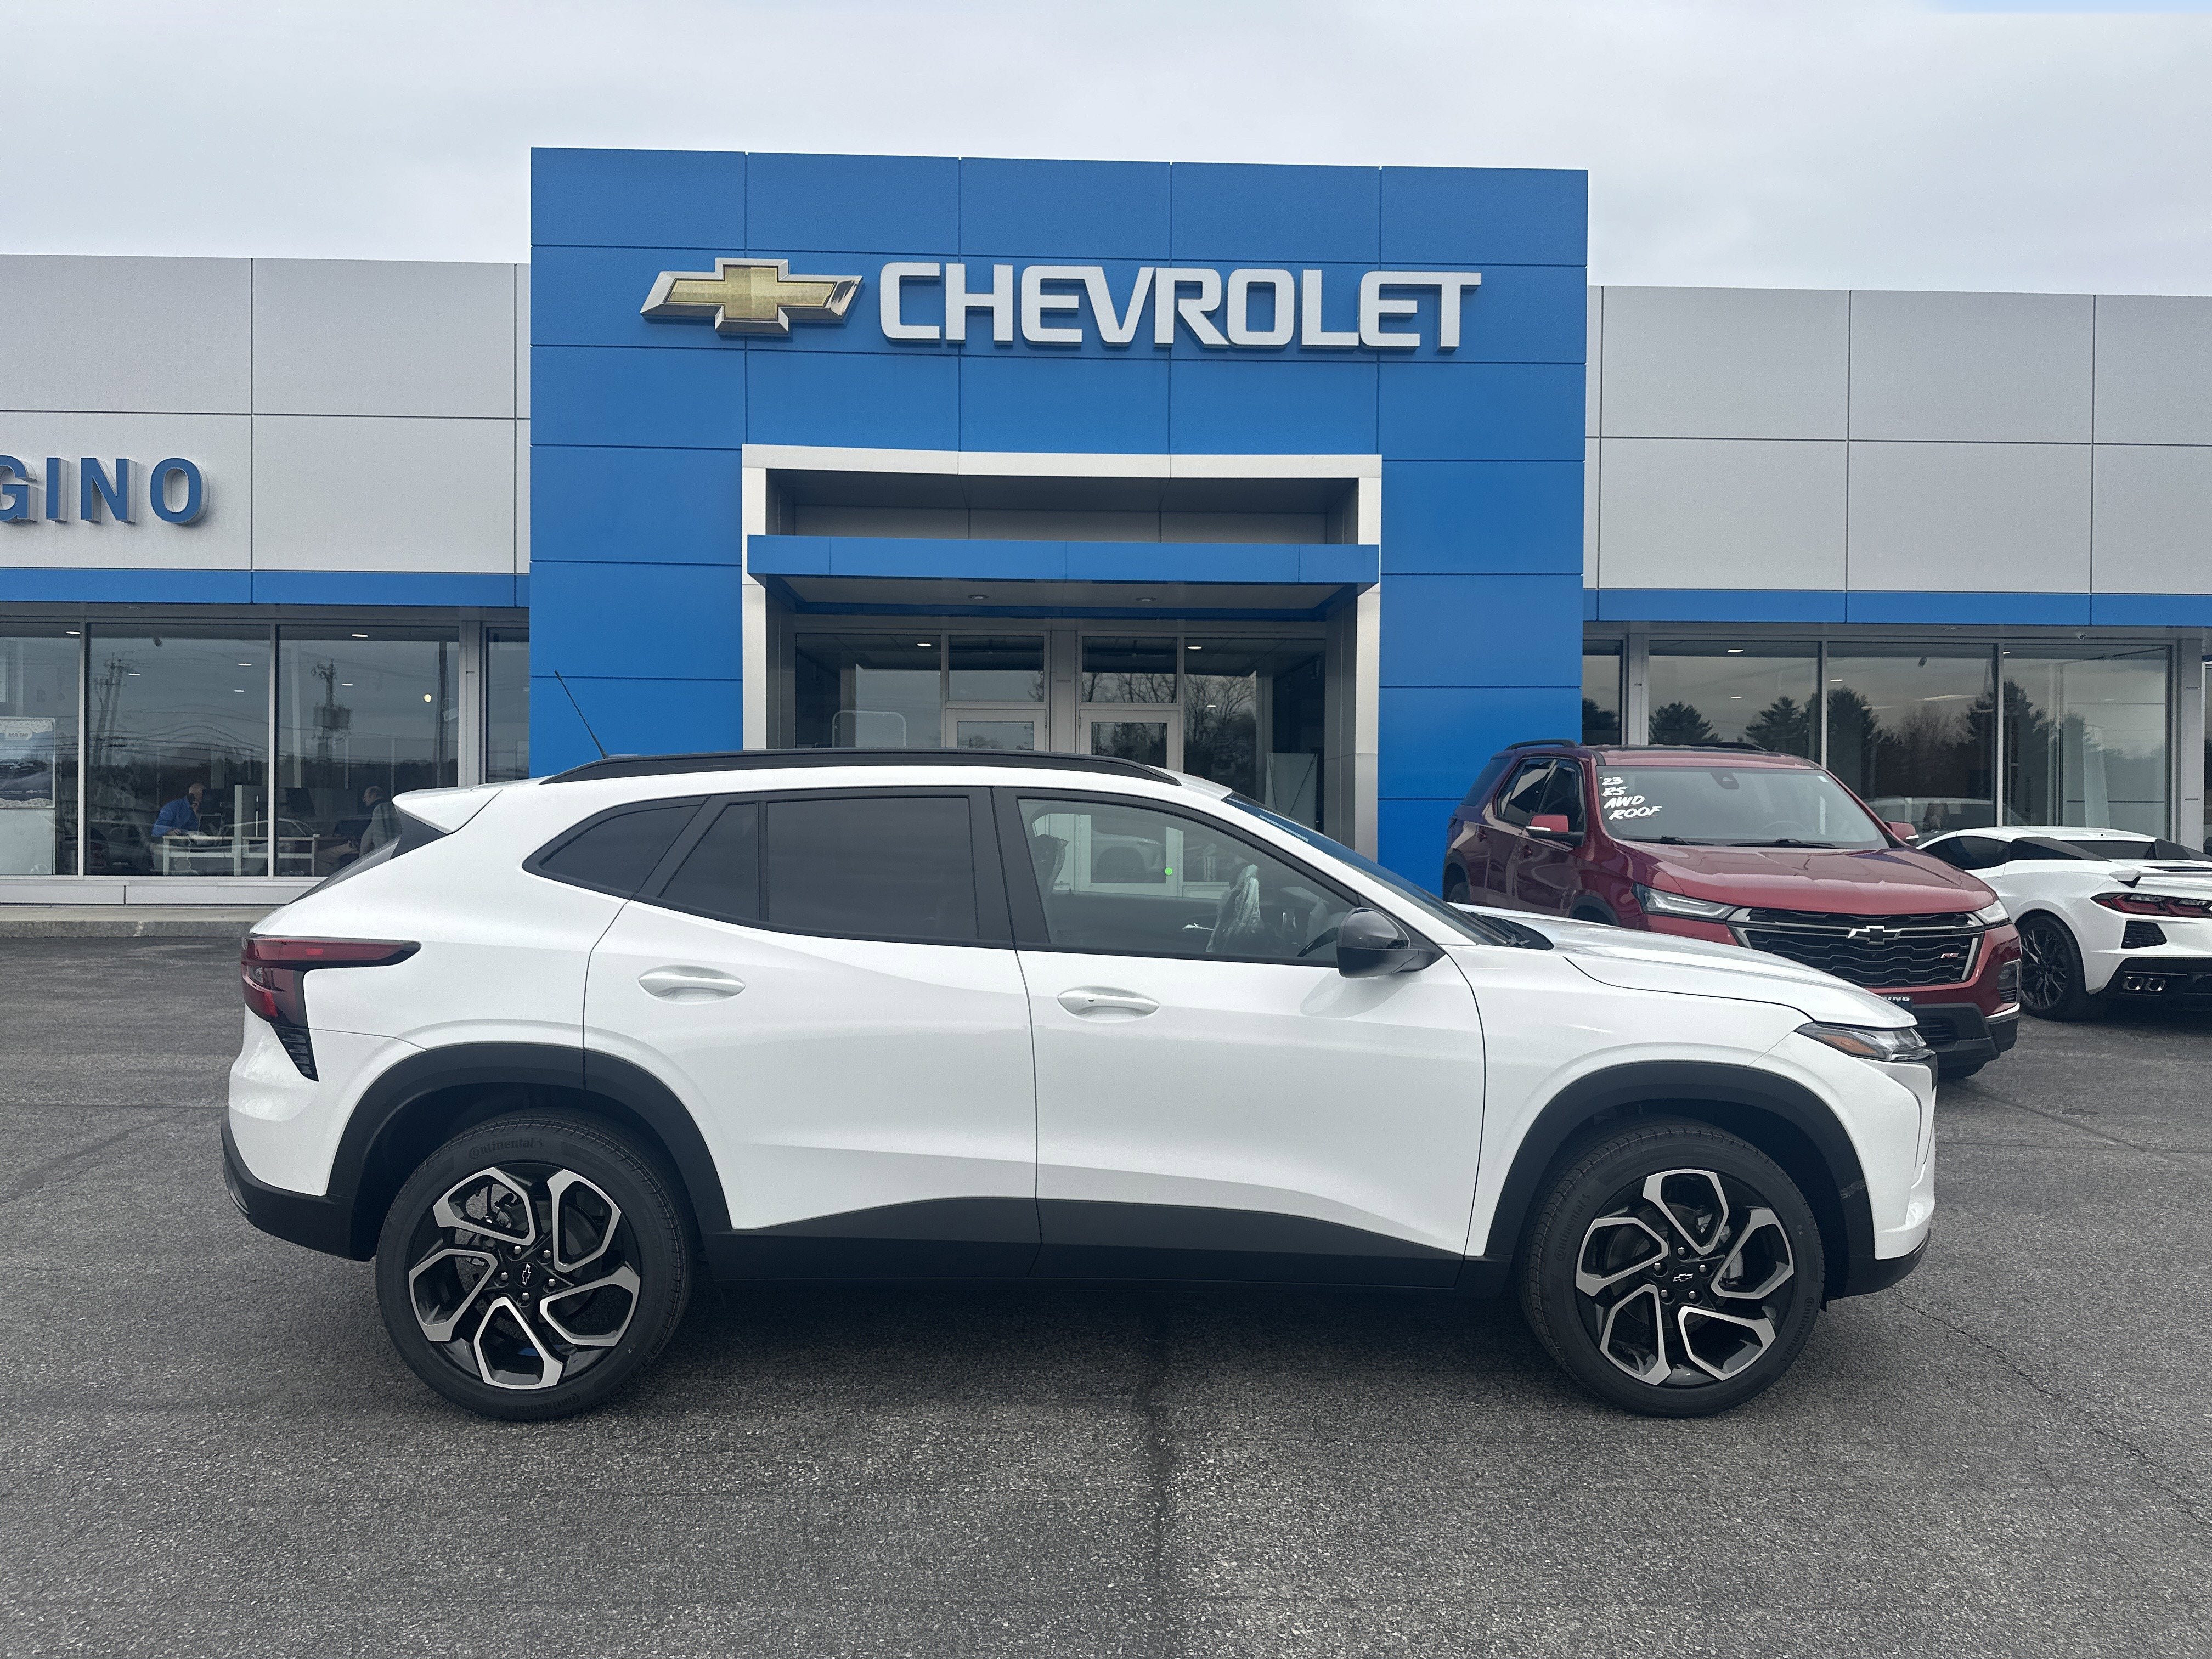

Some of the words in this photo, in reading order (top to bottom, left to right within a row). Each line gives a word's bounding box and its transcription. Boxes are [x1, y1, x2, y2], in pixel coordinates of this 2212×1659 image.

[880, 262, 1482, 351] CHEVROLET
[1602, 786, 1627, 797] RS
[1604, 795, 1645, 809] AWD
[1609, 805, 1662, 820] ROOF
[468, 1137, 534, 1159] Continental
[1554, 1200, 1586, 1261] Continental
